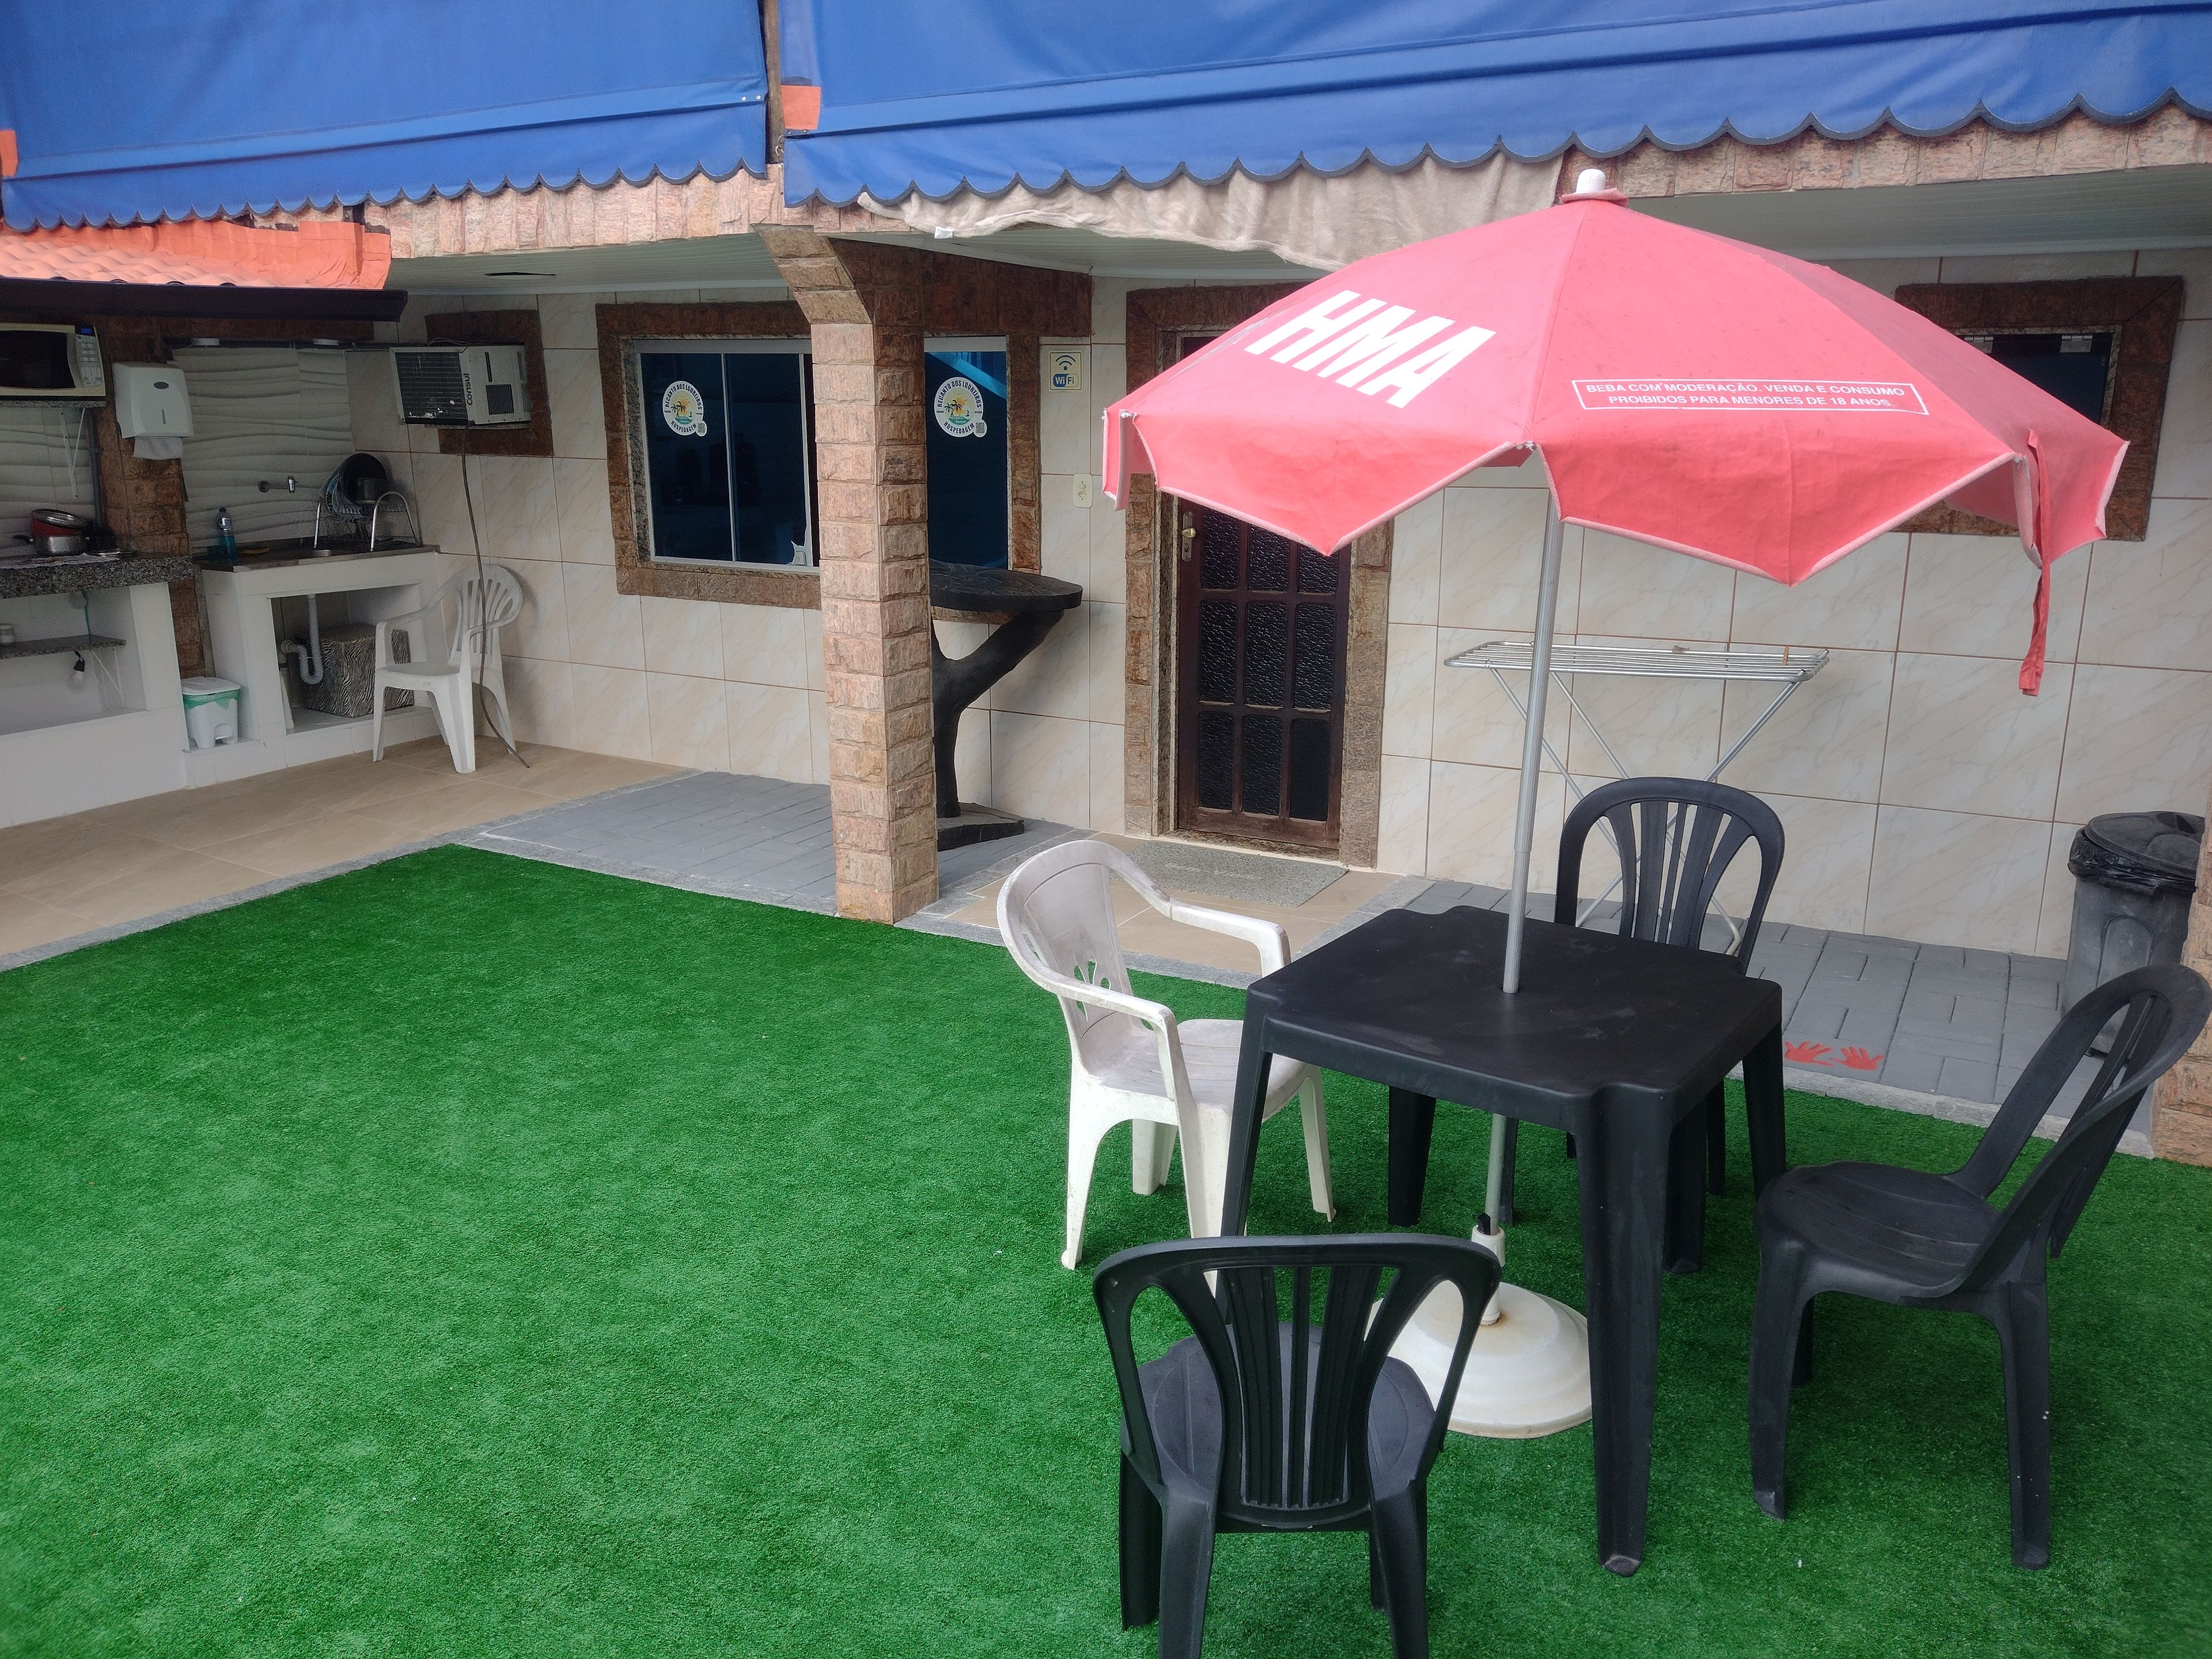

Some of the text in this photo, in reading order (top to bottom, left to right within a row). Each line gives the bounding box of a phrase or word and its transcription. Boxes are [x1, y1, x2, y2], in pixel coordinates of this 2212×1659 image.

[937, 383, 952, 407] RECANTO
[963, 381, 982, 408] LOUREIROS
[1586, 384, 1627, 393] BEBA
[1628, 383, 1661, 392] COM
[1763, 384, 1815, 393] VENDA
[1816, 385, 1828, 393] E
[1829, 385, 1905, 396] CONSUMO
[665, 386, 677, 408] RECANTO
[685, 385, 702, 410] LOUREIROS
[1608, 396, 1688, 404] PROIBIDOS
[1690, 396, 1730, 404] PARA
[1731, 396, 1804, 405] MENORES
[1806, 397, 1828, 405] DE
[1830, 397, 1847, 406] 18
[671, 421, 697, 433] HOSPEDAGEM
[944, 421, 975, 434] HOSPEDAGEM
